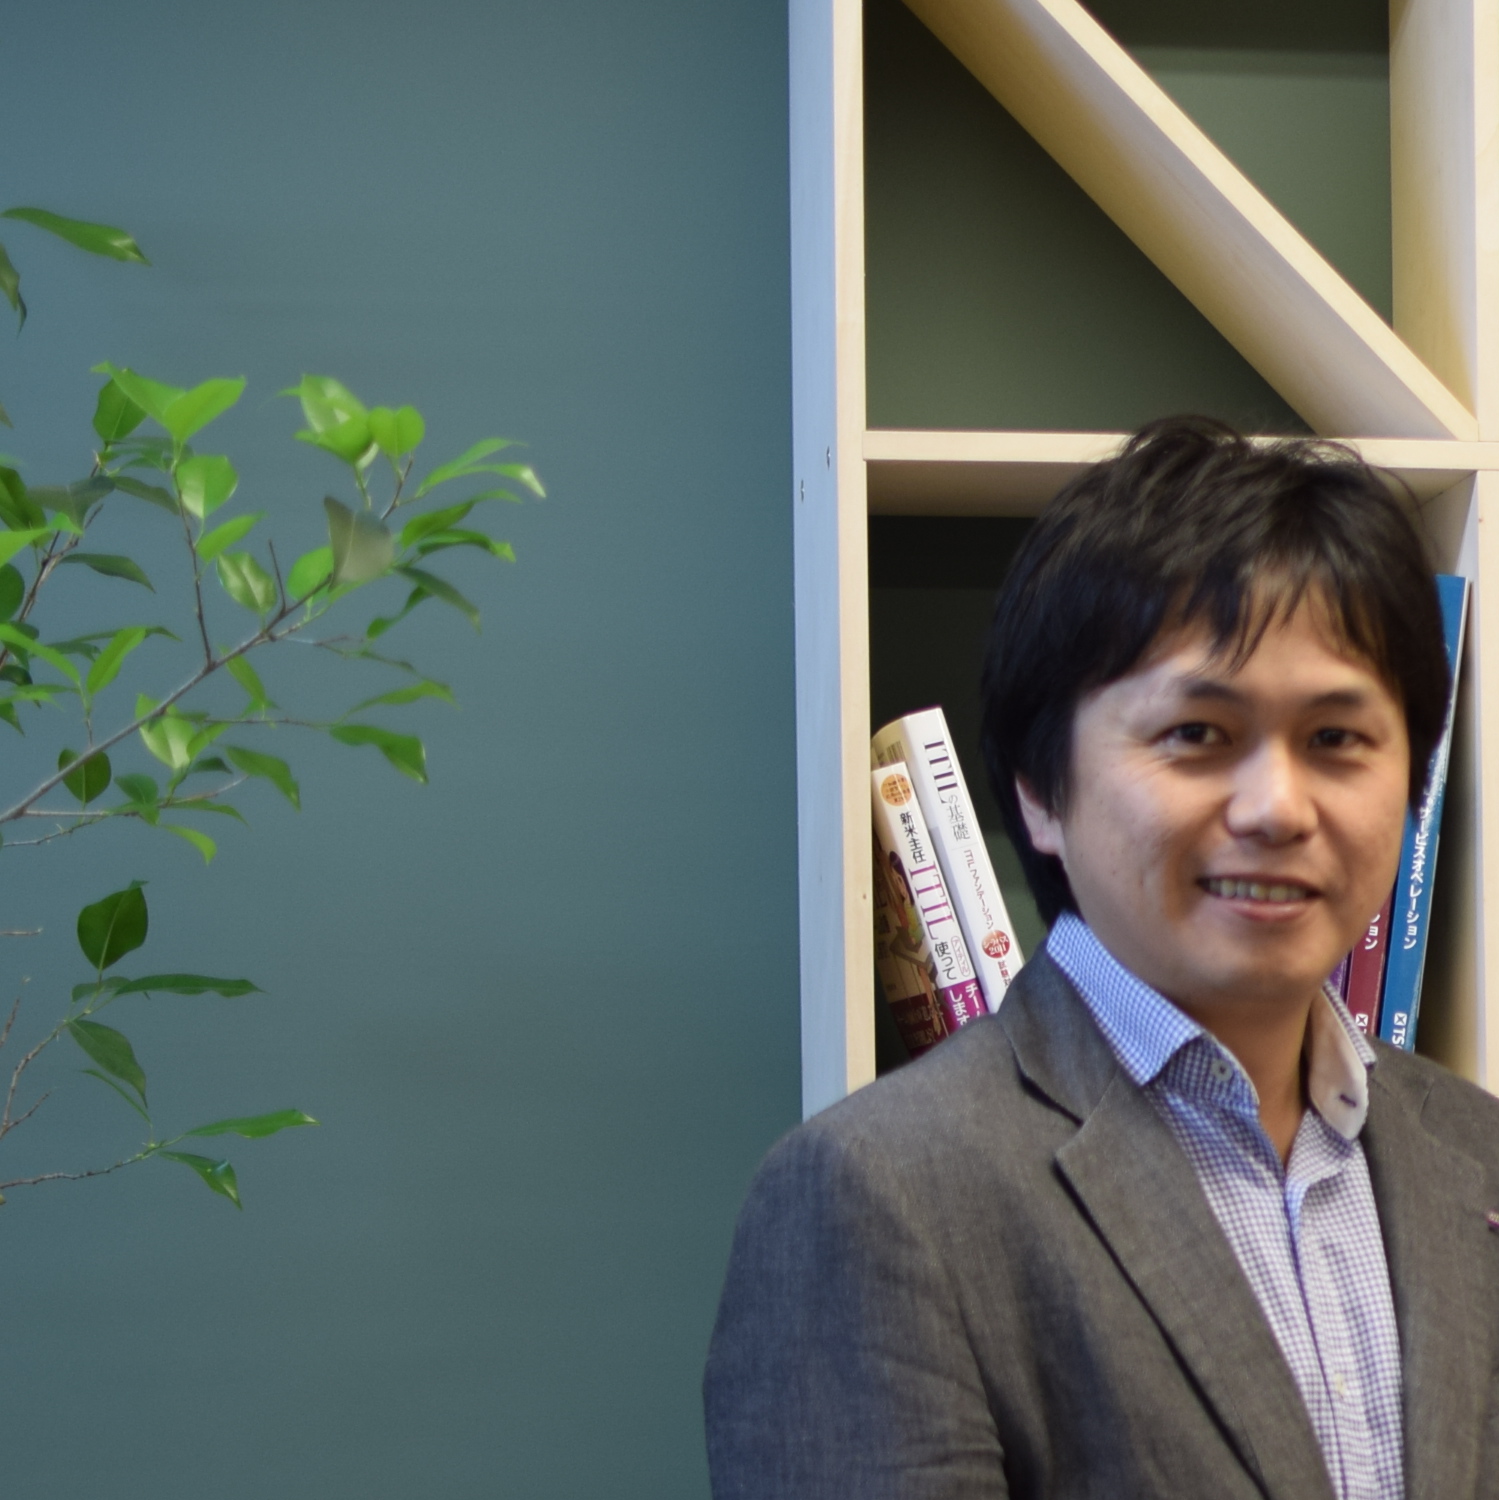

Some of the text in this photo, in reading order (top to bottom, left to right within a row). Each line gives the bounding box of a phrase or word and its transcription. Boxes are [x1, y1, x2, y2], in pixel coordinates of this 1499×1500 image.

[924, 741, 970, 841] ITILの基礎
[900, 812, 957, 981] 新米主任 ITIL 使って
